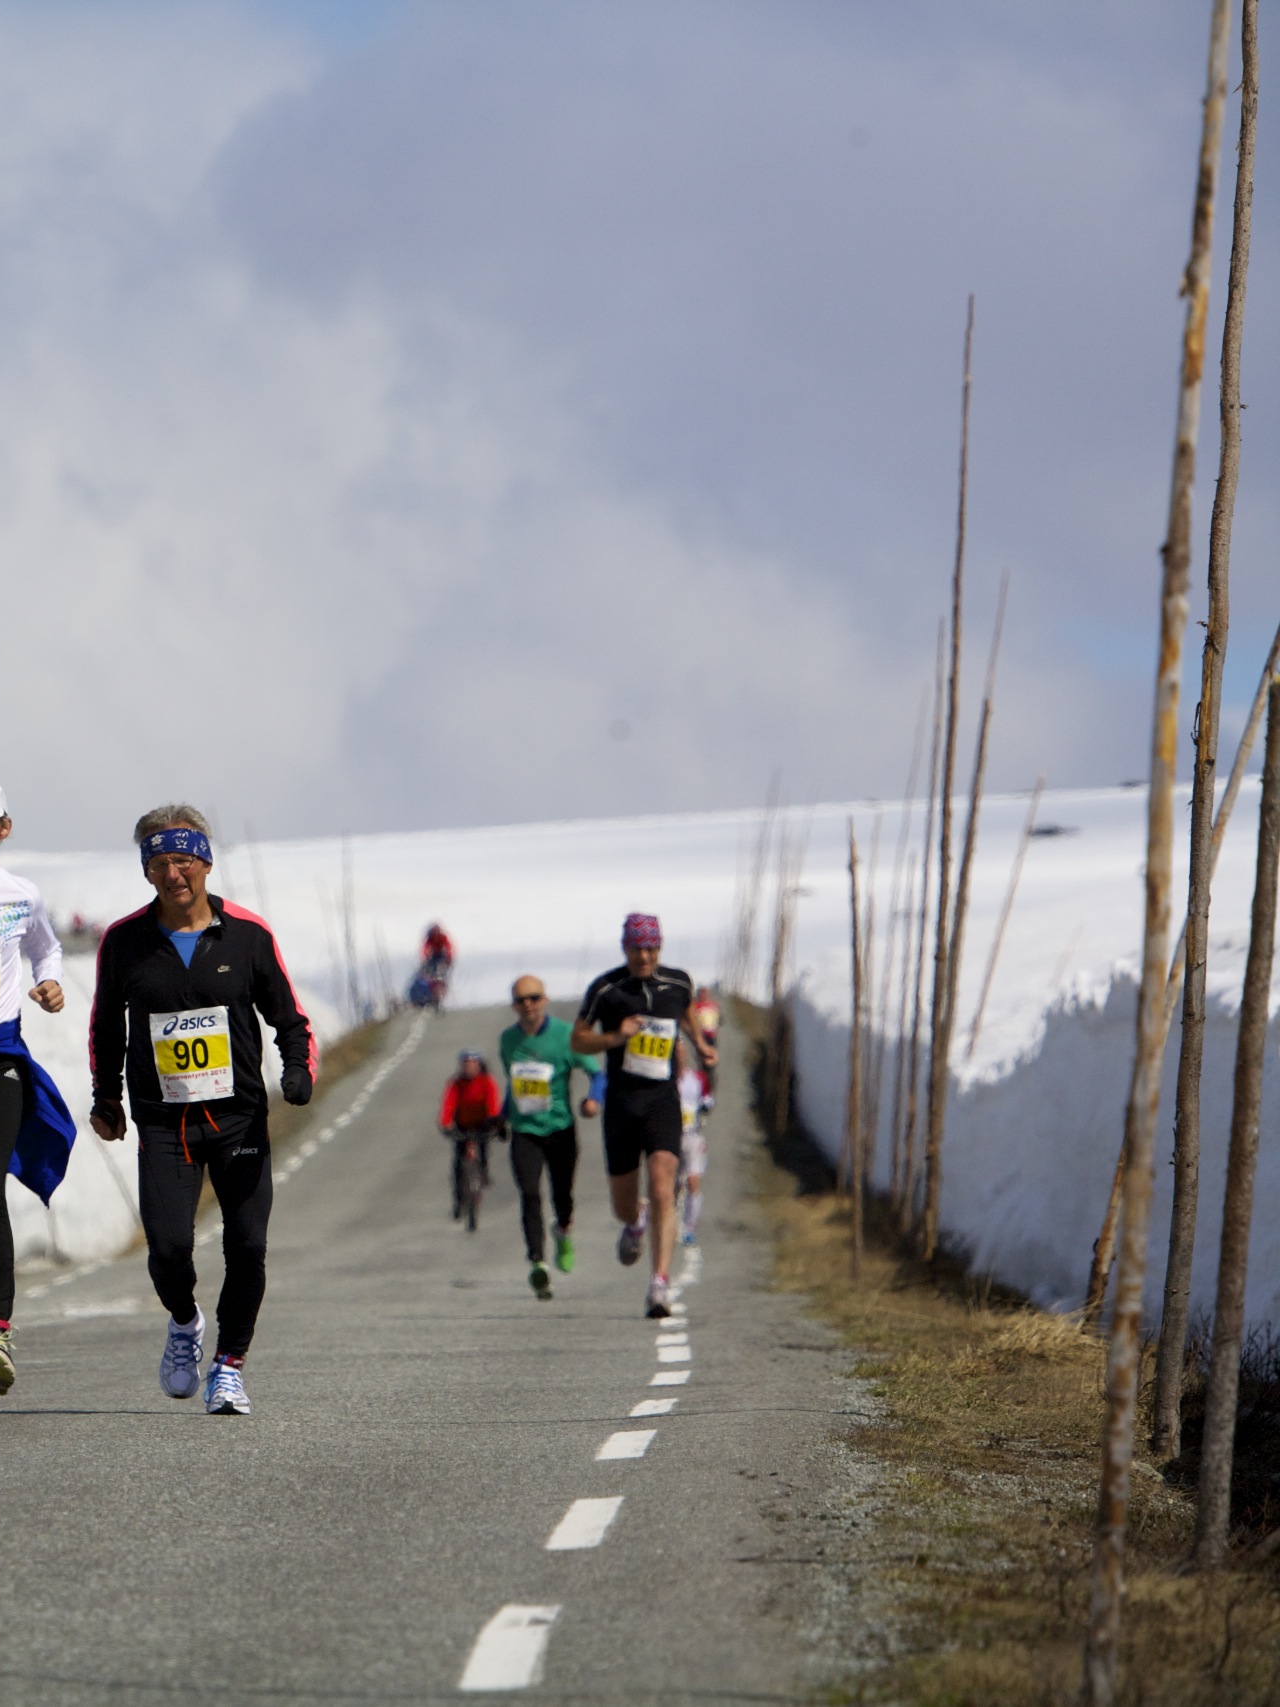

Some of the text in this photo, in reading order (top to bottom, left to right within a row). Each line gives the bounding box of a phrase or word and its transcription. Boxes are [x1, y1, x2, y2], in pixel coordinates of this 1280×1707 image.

[173, 1037, 209, 1071] 90
[163, 1068, 227, 1082] Fjelleventyret 2012
